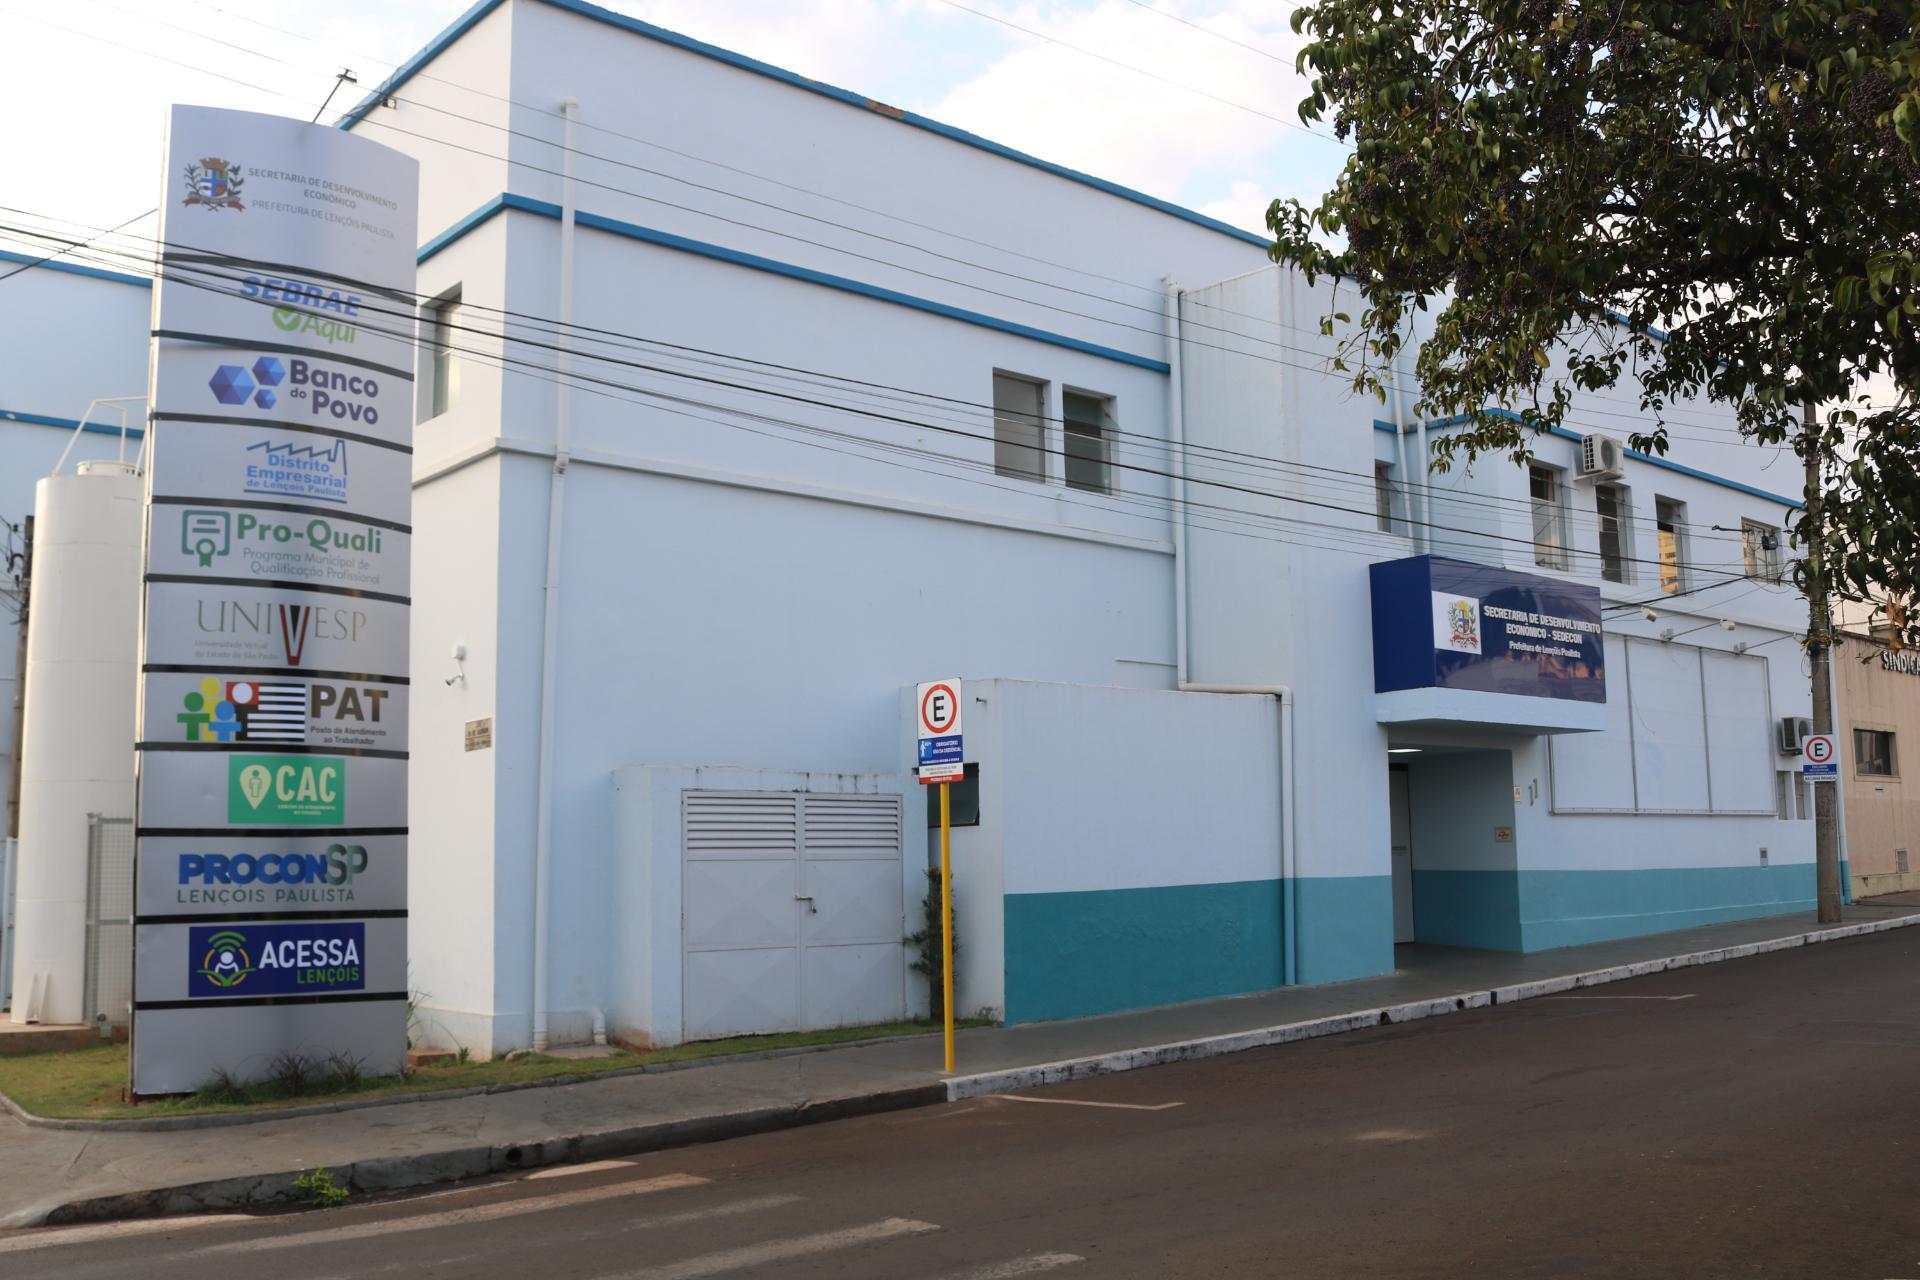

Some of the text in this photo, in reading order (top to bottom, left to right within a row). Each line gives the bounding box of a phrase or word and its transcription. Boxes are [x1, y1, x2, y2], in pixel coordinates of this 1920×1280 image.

[249, 168, 307, 184] SECRETARIA
[308, 177, 320, 187] DE
[252, 200, 309, 216] PREFEITURA
[311, 208, 323, 219] DE
[240, 276, 361, 317] SEBRAE
[301, 312, 357, 344] Aqui
[290, 359, 379, 398] Banco
[290, 387, 378, 425] do Povo
[268, 454, 330, 473] Distrito
[247, 465, 347, 488] Empresarial
[237, 513, 381, 553] Pro-Quali
[243, 548, 369, 570] Programa Municipal de
[250, 561, 380, 585] Qualificação Profissional
[1484, 605, 1601, 634] SECRETARIA DE DESENVOLVIMENTO
[198, 599, 367, 666] UNIVESP
[1552, 630, 1582, 644] SEDECON
[311, 684, 389, 722] PAT
[934, 696, 945, 721] E
[1815, 743, 1824, 756] E
[276, 765, 336, 803] CAC
[177, 886, 355, 906] LENÇÓIS PAULISTA
[259, 938, 360, 968] ACESSA
[297, 966, 359, 985] LENÇÓIS
